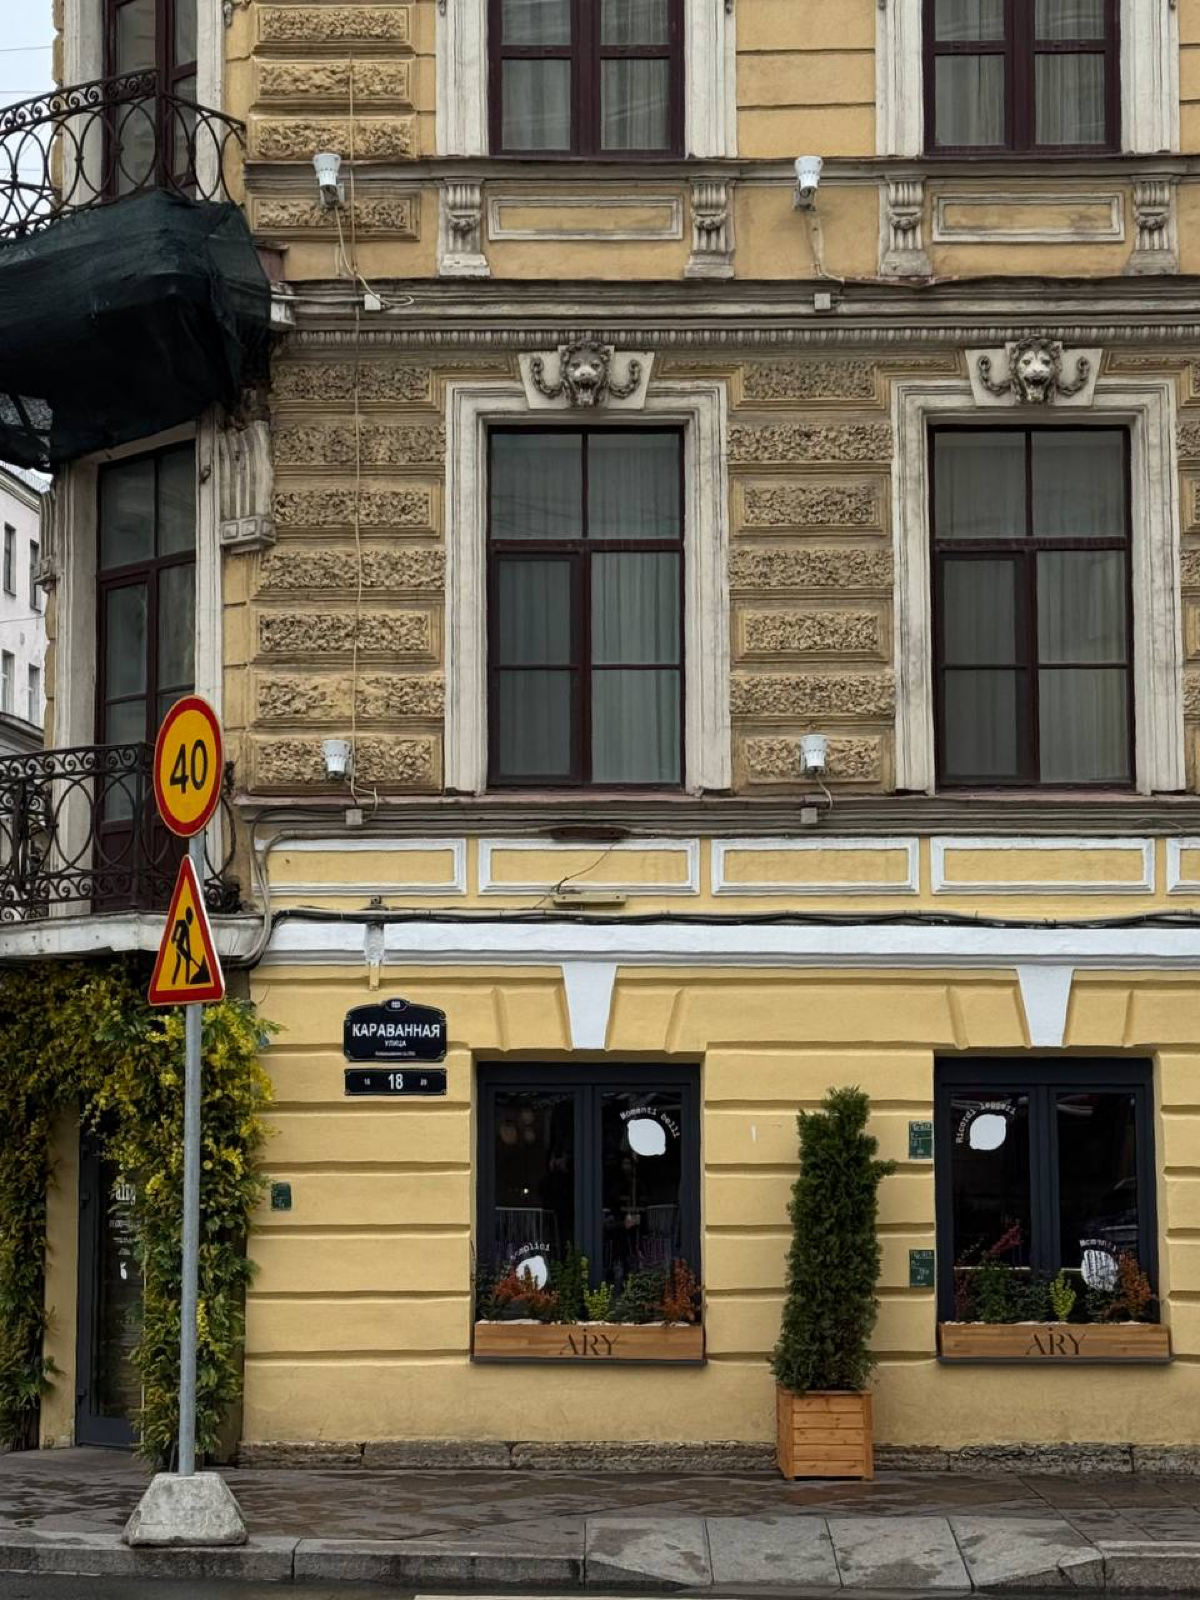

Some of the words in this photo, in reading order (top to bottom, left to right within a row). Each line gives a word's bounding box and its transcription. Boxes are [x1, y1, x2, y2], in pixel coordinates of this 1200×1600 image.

[169, 739, 208, 794] 40
[352, 1023, 440, 1037] КАРАВАННАЯ
[388, 1073, 403, 1090] 18
